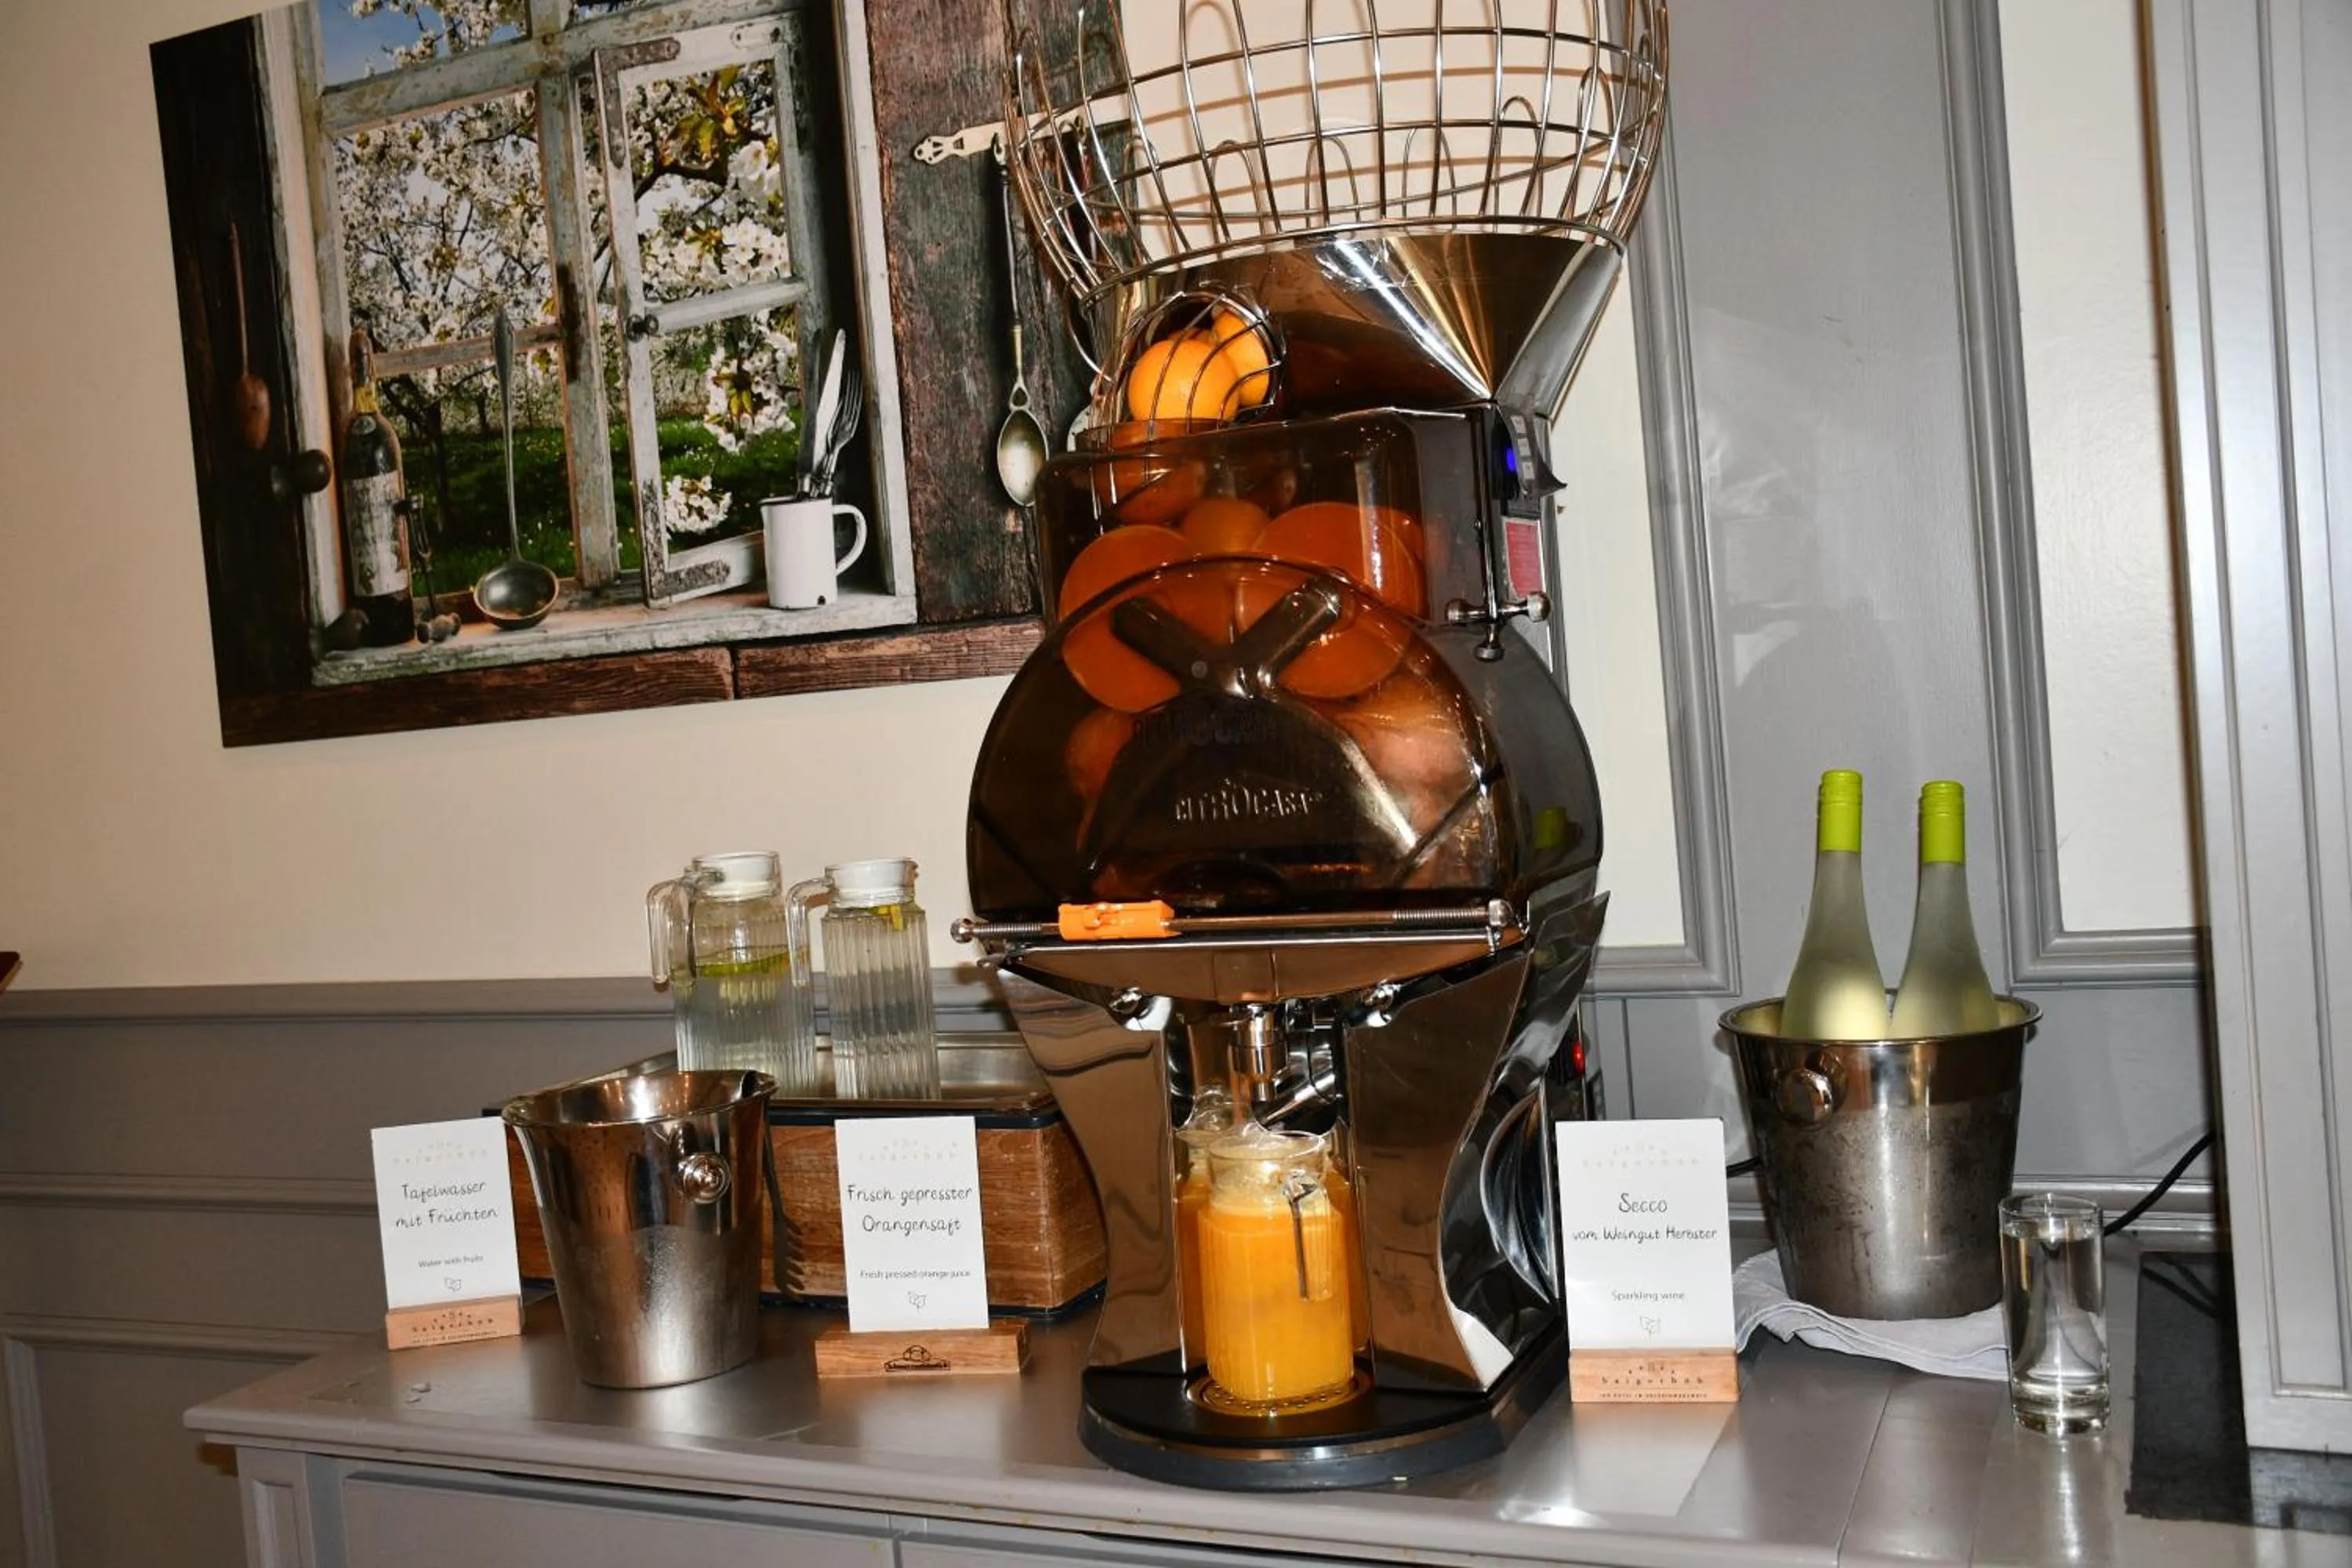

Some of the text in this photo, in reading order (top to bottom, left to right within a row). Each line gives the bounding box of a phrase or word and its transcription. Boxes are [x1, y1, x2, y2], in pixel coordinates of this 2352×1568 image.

[401, 1181, 488, 1203] Tafelwasser
[847, 1184, 973, 1207] Frisch gepresster
[1618, 1192, 1668, 1214] Secco
[395, 1216, 422, 1229] mit
[862, 1214, 962, 1237] Orangensaft
[1603, 1225, 1661, 1244] Weingut
[1612, 1289, 1659, 1301] Sparkling
